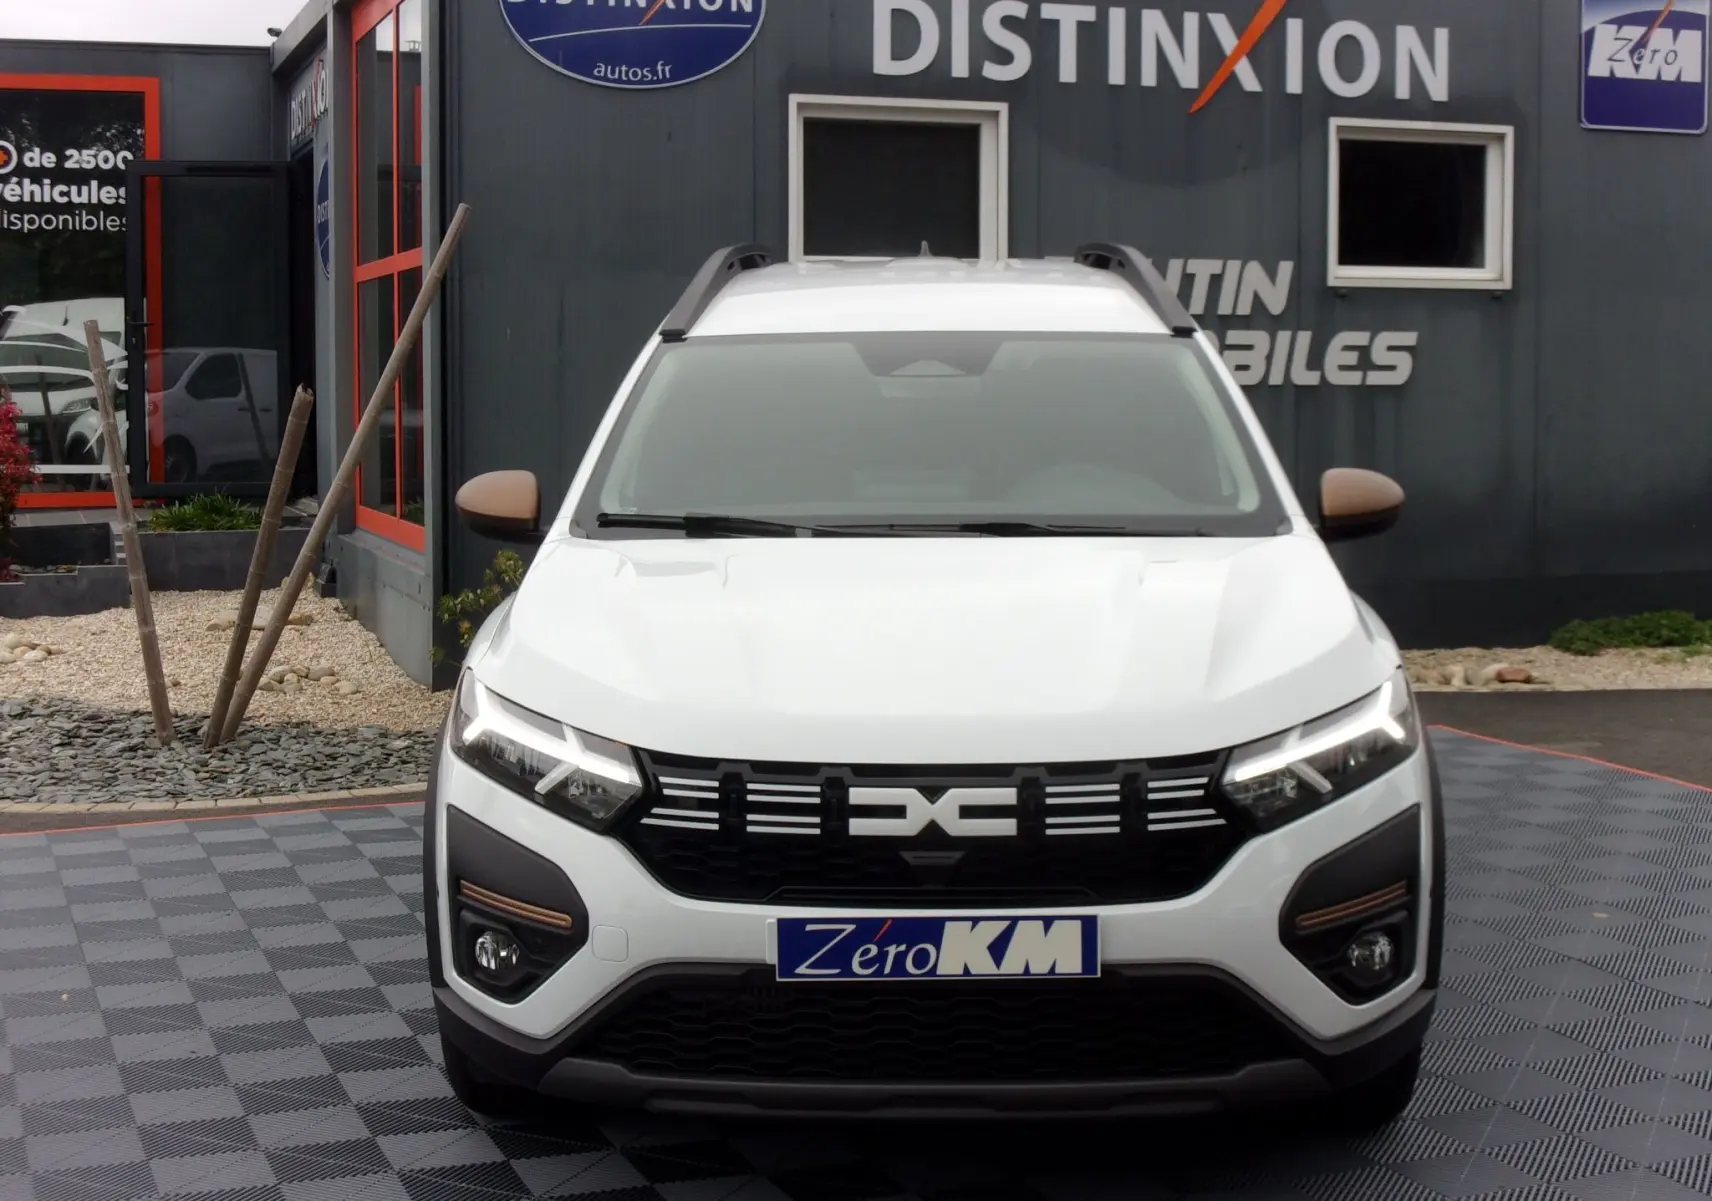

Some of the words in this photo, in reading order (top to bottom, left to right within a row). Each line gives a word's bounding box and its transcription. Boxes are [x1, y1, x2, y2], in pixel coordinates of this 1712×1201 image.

[872, 0, 1449, 113] DISTINXION
[593, 60, 673, 82] autos.fr
[23, 147, 57, 168] de
[0, 176, 126, 205] éhicule
[0, 209, 127, 233] isponible
[1200, 330, 1419, 386] BILES
